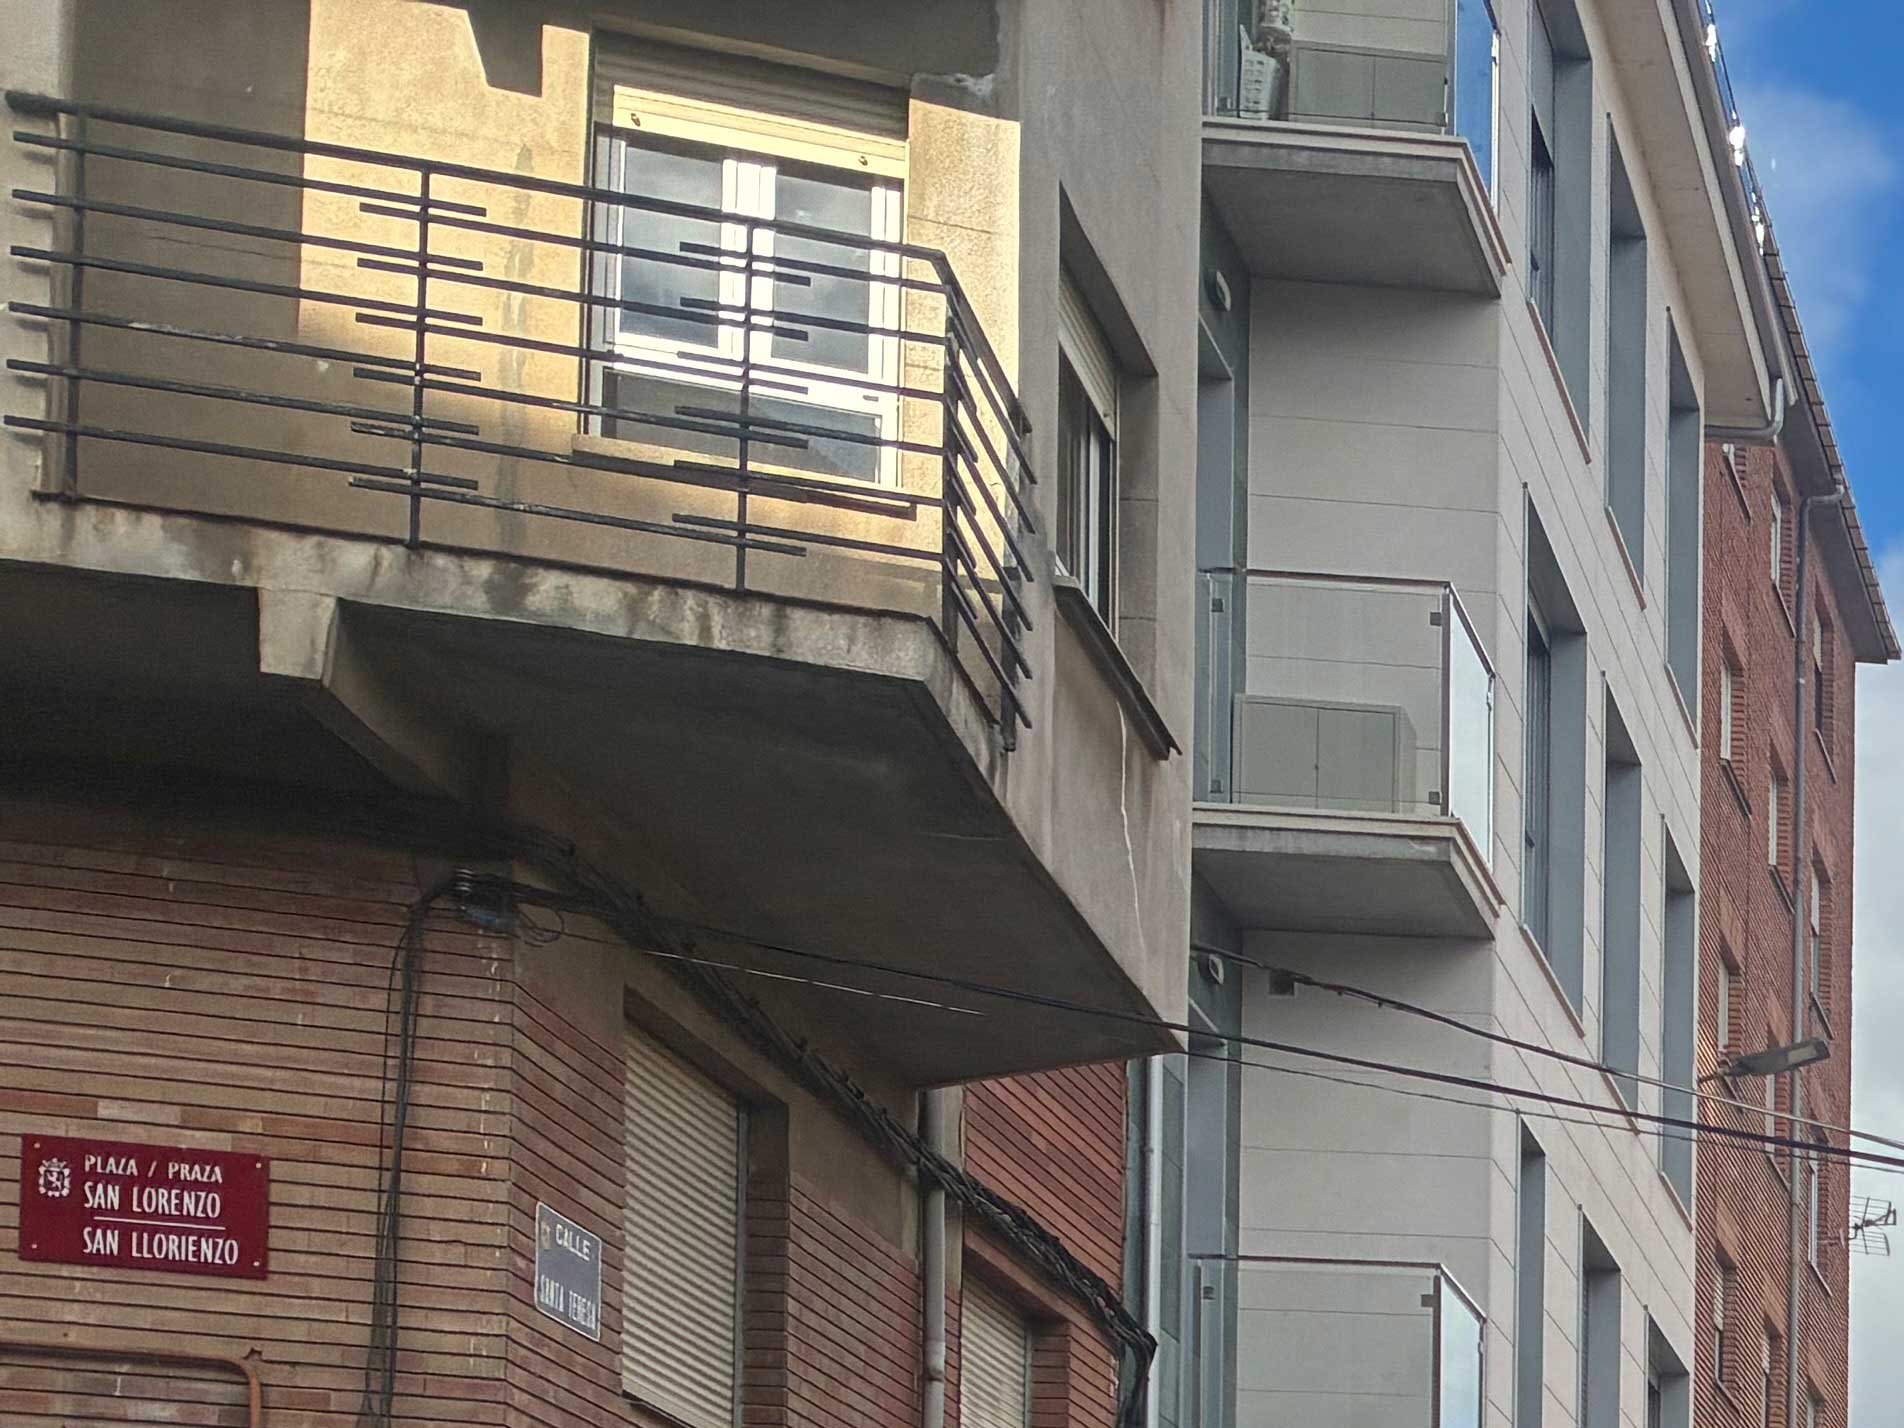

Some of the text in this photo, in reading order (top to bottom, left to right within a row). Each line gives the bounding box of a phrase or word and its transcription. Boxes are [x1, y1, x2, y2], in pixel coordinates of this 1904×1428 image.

[84, 1154, 138, 1177] PLAZA
[168, 1161, 223, 1184] PRAZA
[84, 1181, 221, 1218] SAN LORENZO
[83, 1227, 239, 1265] SAN LLORIENZO
[555, 1223, 590, 1261] CALLE
